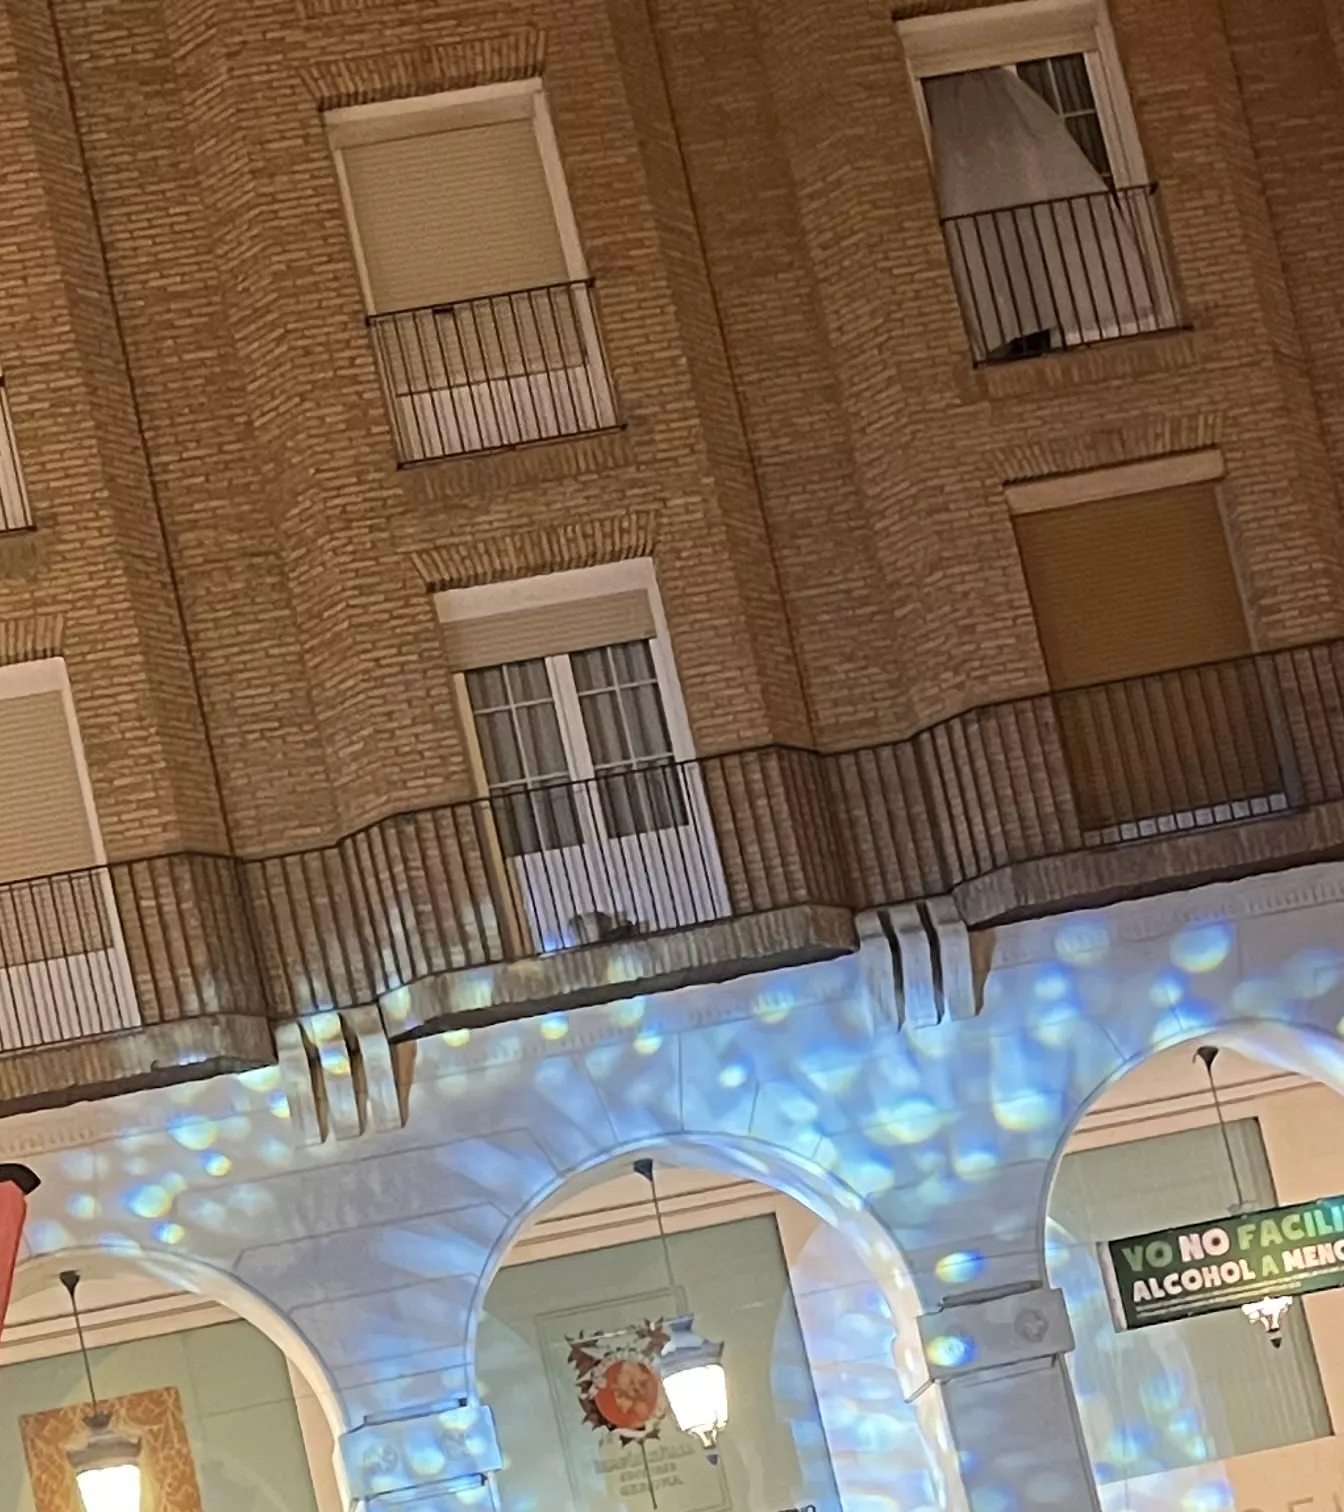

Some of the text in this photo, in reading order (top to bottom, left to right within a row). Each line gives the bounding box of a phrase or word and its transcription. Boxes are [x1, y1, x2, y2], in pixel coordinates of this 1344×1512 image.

[1121, 1239, 1173, 1272] YO
[1177, 1228, 1231, 1263] NO
[1132, 1258, 1256, 1303] ALCOHOL
[1261, 1254, 1280, 1278] A
